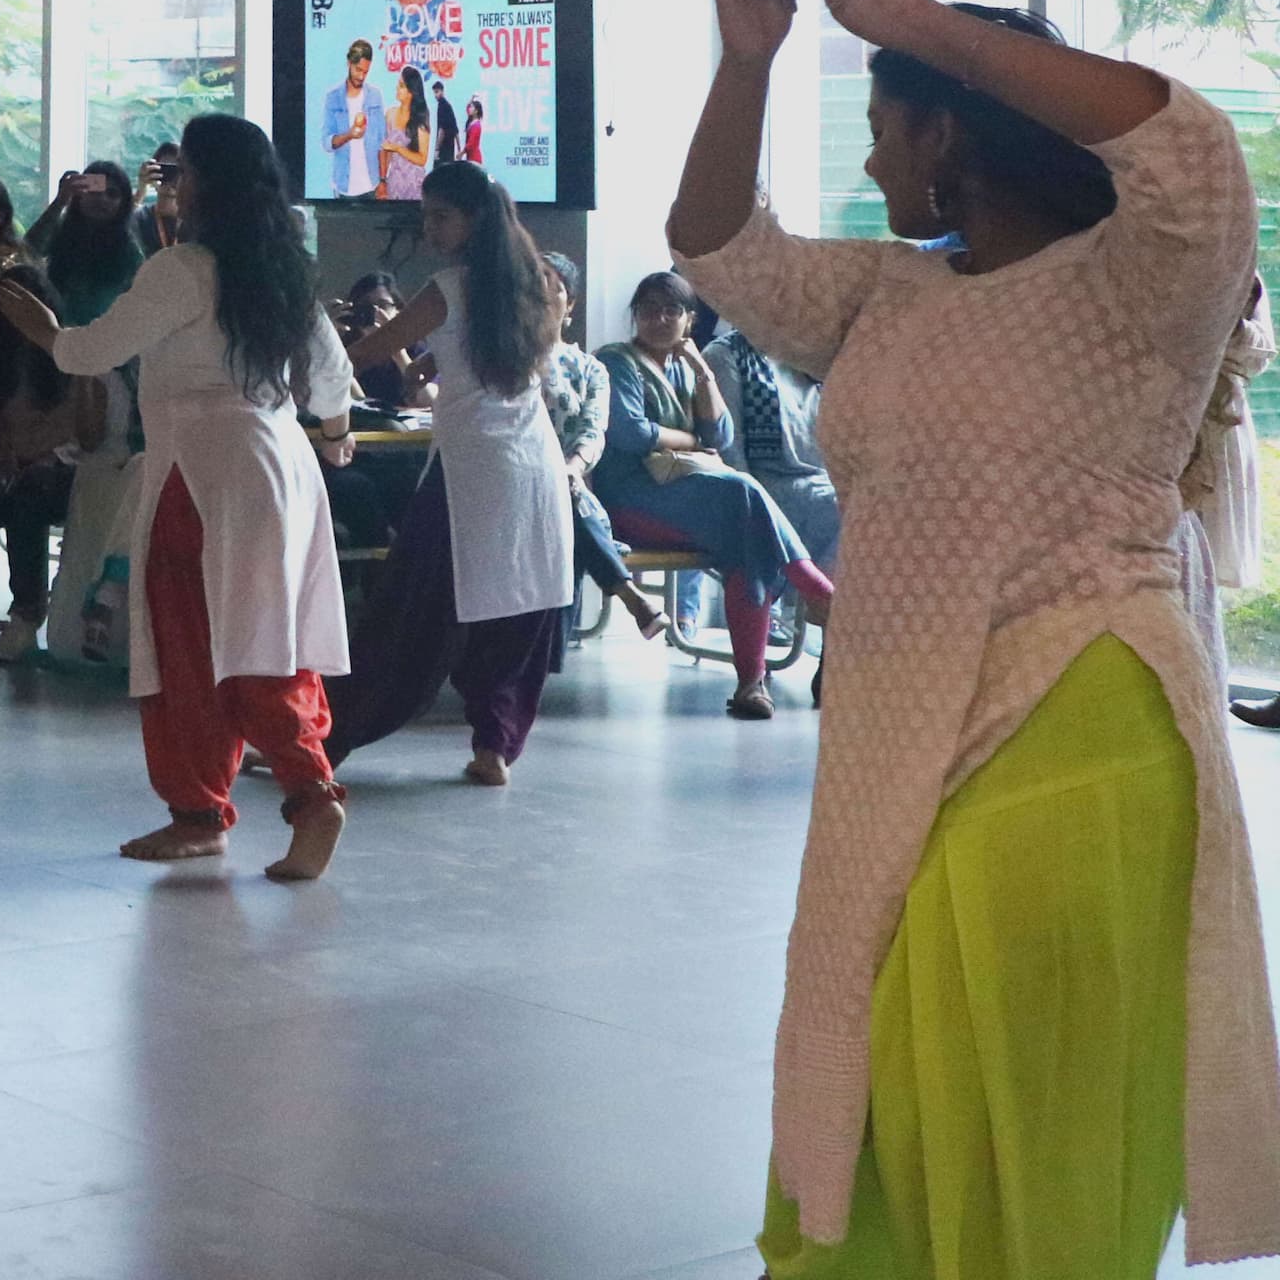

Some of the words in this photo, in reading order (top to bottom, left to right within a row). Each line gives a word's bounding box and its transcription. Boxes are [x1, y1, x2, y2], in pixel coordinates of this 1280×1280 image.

[385, 1, 463, 39] LOVE
[477, 12, 514, 27] THERE'S
[516, 10, 552, 25] ALWAYS
[387, 44, 402, 63] KA
[479, 27, 551, 69] SOME
[479, 89, 551, 133] LOVE
[520, 136, 535, 146] COME
[537, 136, 549, 146] AND
[514, 147, 549, 157] EXPERIENCE
[506, 157, 520, 166] THAT
[521, 157, 549, 167] MADNESS
